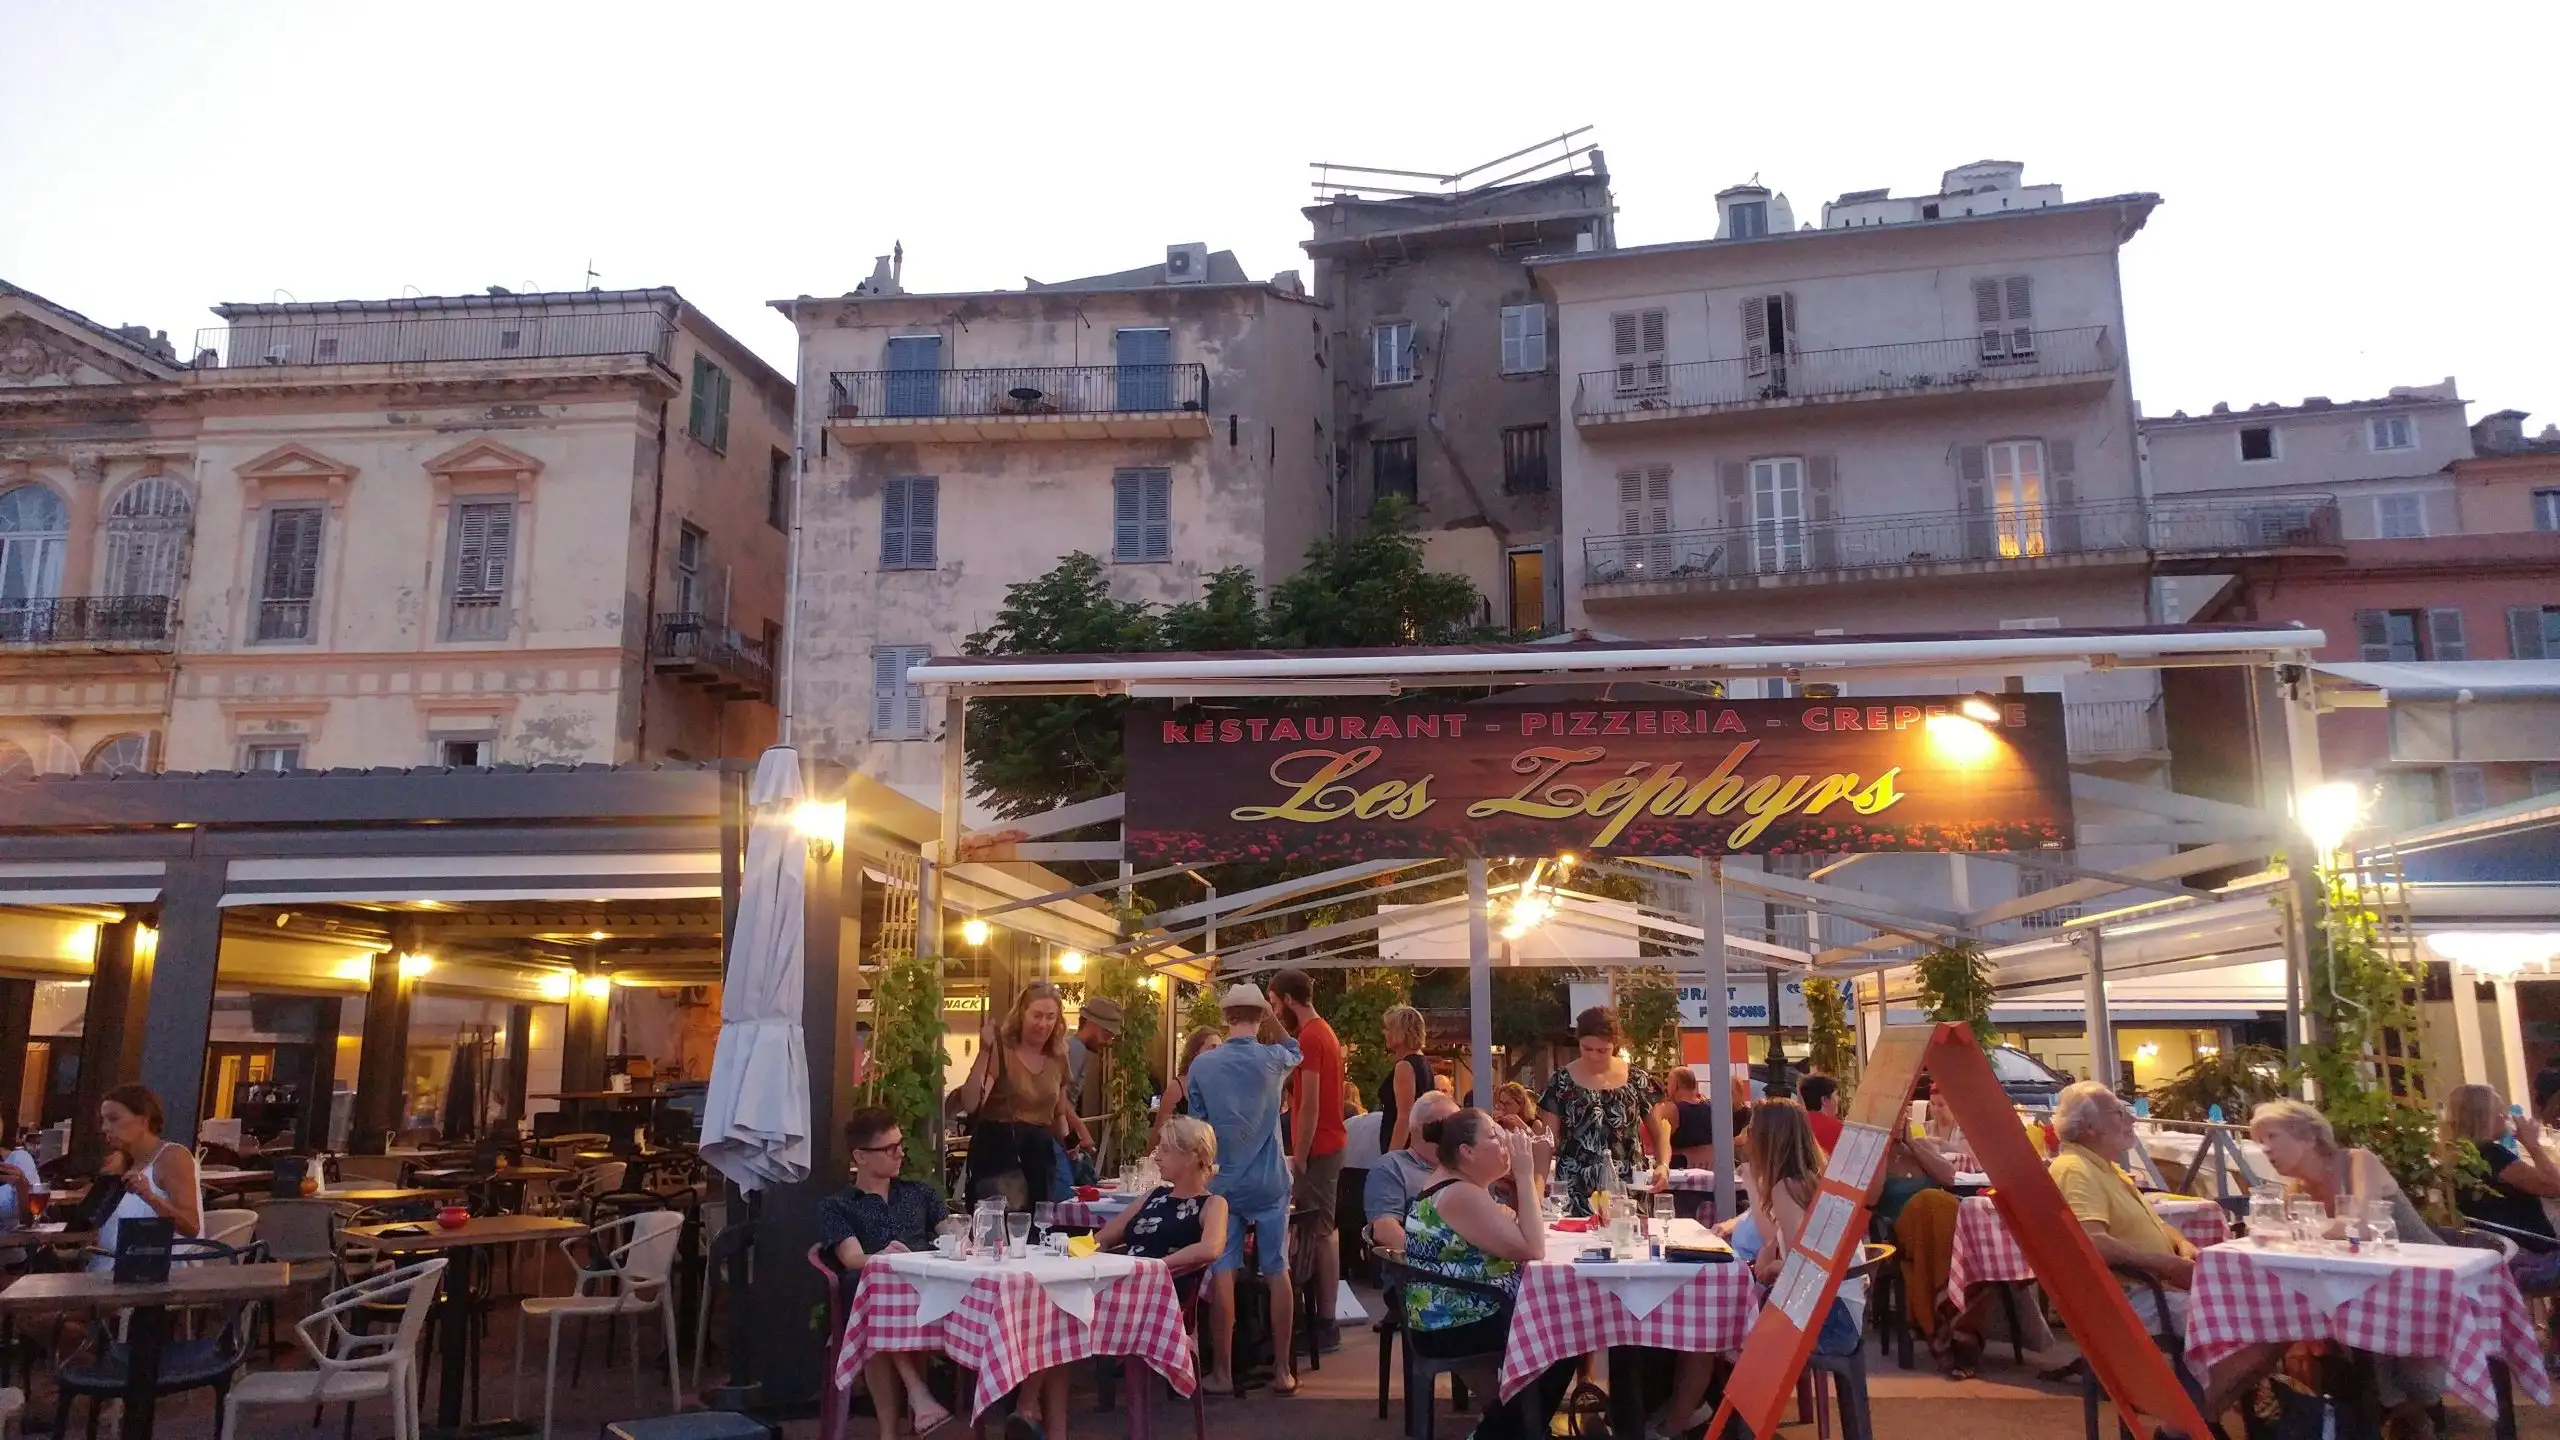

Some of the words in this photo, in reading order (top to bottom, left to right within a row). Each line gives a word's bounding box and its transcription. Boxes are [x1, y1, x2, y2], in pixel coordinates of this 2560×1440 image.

[1163, 714, 1467, 743] RESTAURANT
[1521, 709, 1747, 736] PIZZERIA
[1802, 703, 2027, 731] CREPE
[1231, 746, 1438, 821] Les
[1466, 738, 1906, 849] Zéphyrs
[944, 999, 980, 1010] NACK
[1699, 1005, 1766, 1017] PSONS
